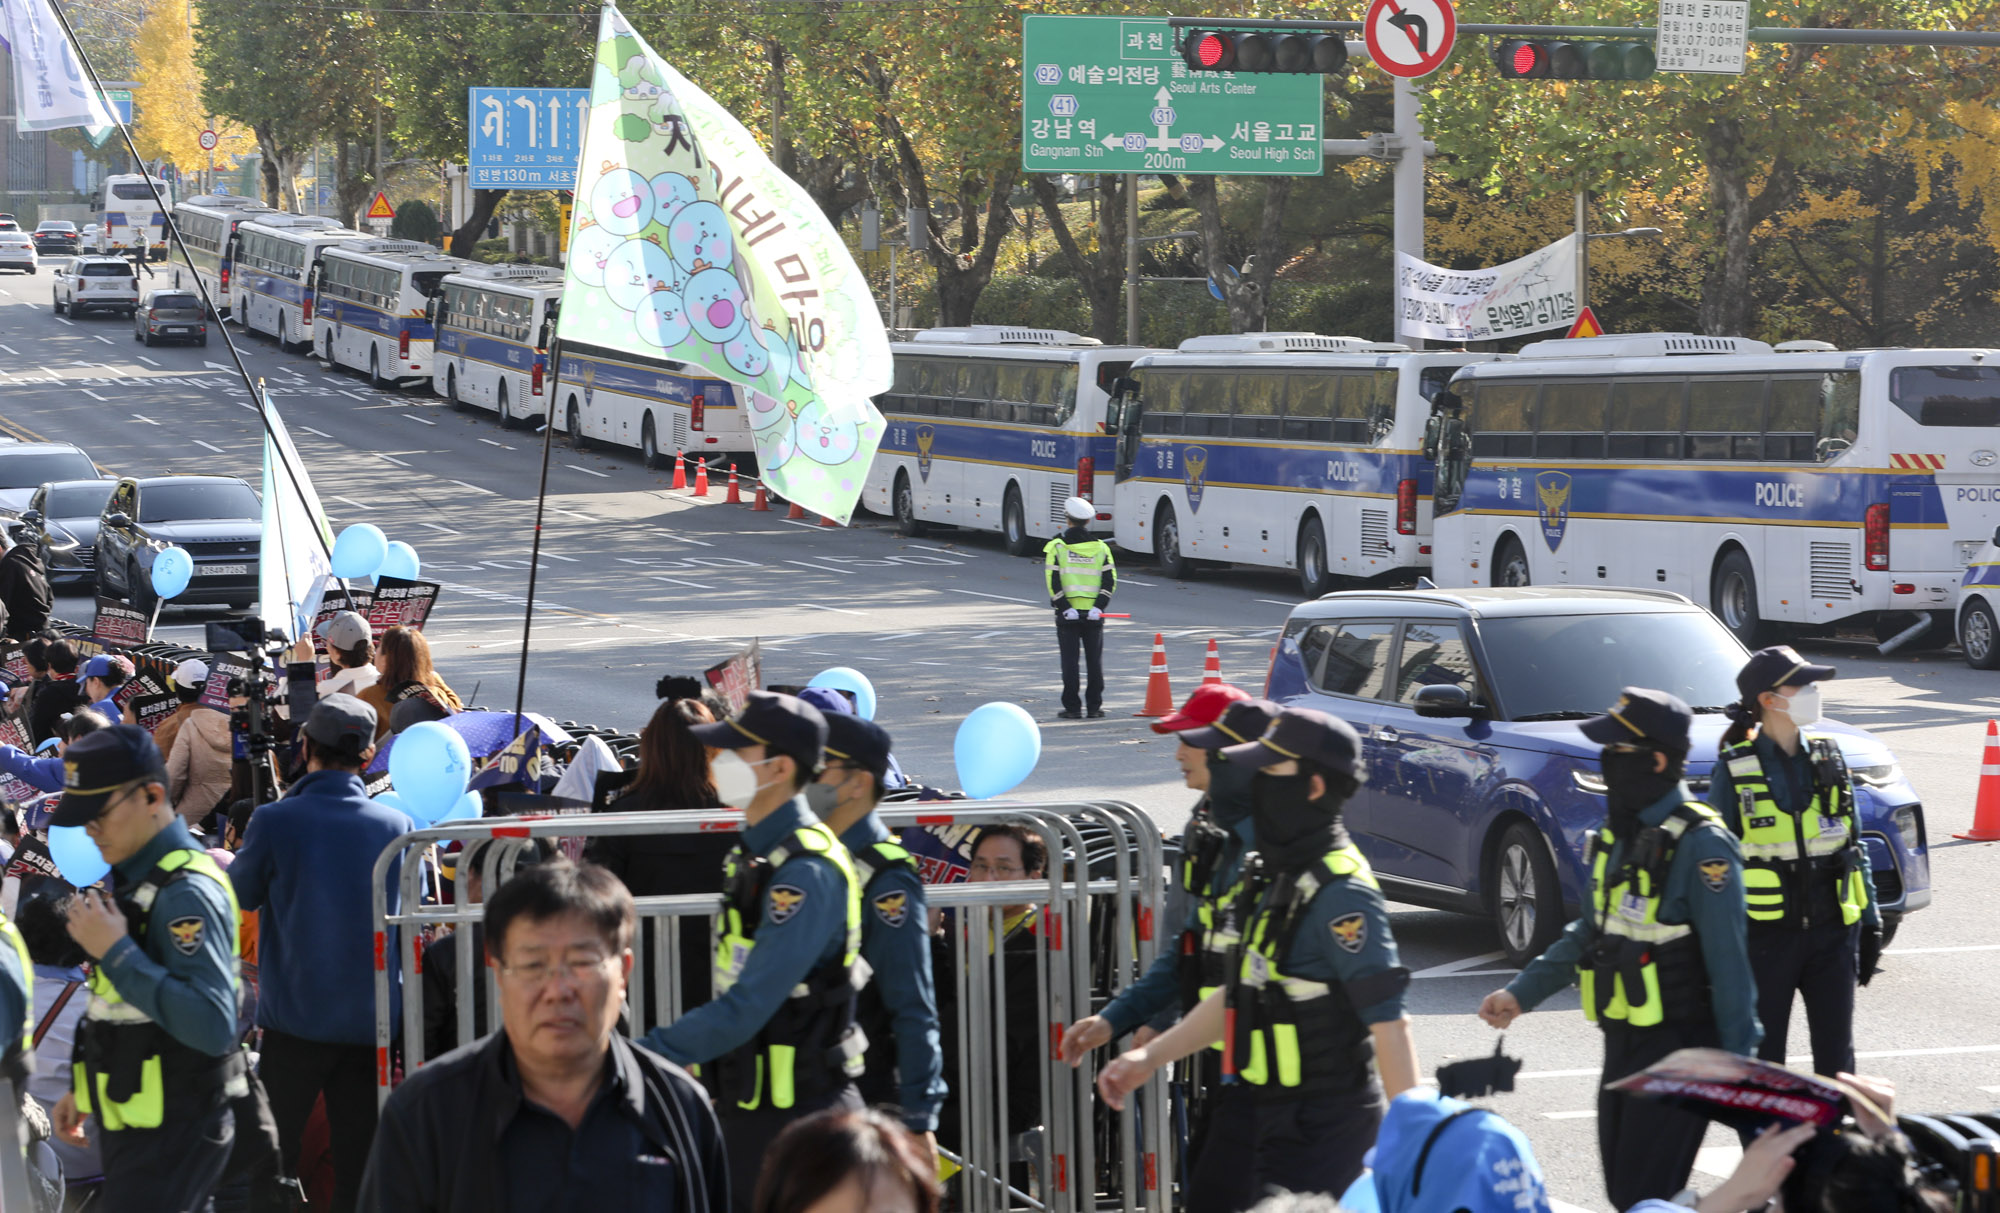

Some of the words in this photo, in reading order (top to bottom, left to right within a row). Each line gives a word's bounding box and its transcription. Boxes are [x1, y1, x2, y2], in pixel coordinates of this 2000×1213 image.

[1702, 4, 1744, 20] 금지시간
[1127, 32, 1163, 50] 과천
[1040, 68, 1058, 82] 92
[1068, 65, 1160, 86] 예술의전당
[1170, 81, 1197, 94] Seoul
[1199, 82, 1221, 94] Arts
[1225, 83, 1257, 95] Center
[1055, 98, 1073, 114] 41
[1156, 110, 1171, 123] 31
[1031, 118, 1096, 140] 강남역
[1230, 121, 1317, 142] 서울고교
[202, 136, 214, 145] 50
[1126, 134, 1143, 150] 90
[1183, 136, 1199, 150] 90
[1030, 143, 1080, 159] Gangnam
[1084, 144, 1104, 157] Stn
[1230, 146, 1261, 160] Seoul
[1264, 147, 1289, 162] High
[1293, 147, 1315, 160] Sch
[1144, 153, 1186, 169] 200m
[1031, 440, 1056, 459] POLICE
[1328, 461, 1359, 481] POLICE
[1498, 477, 1522, 499] 경찰
[1755, 482, 1804, 508] POLICE
[379, 588, 408, 598] 정치검찰
[321, 598, 347, 610] 치검찰
